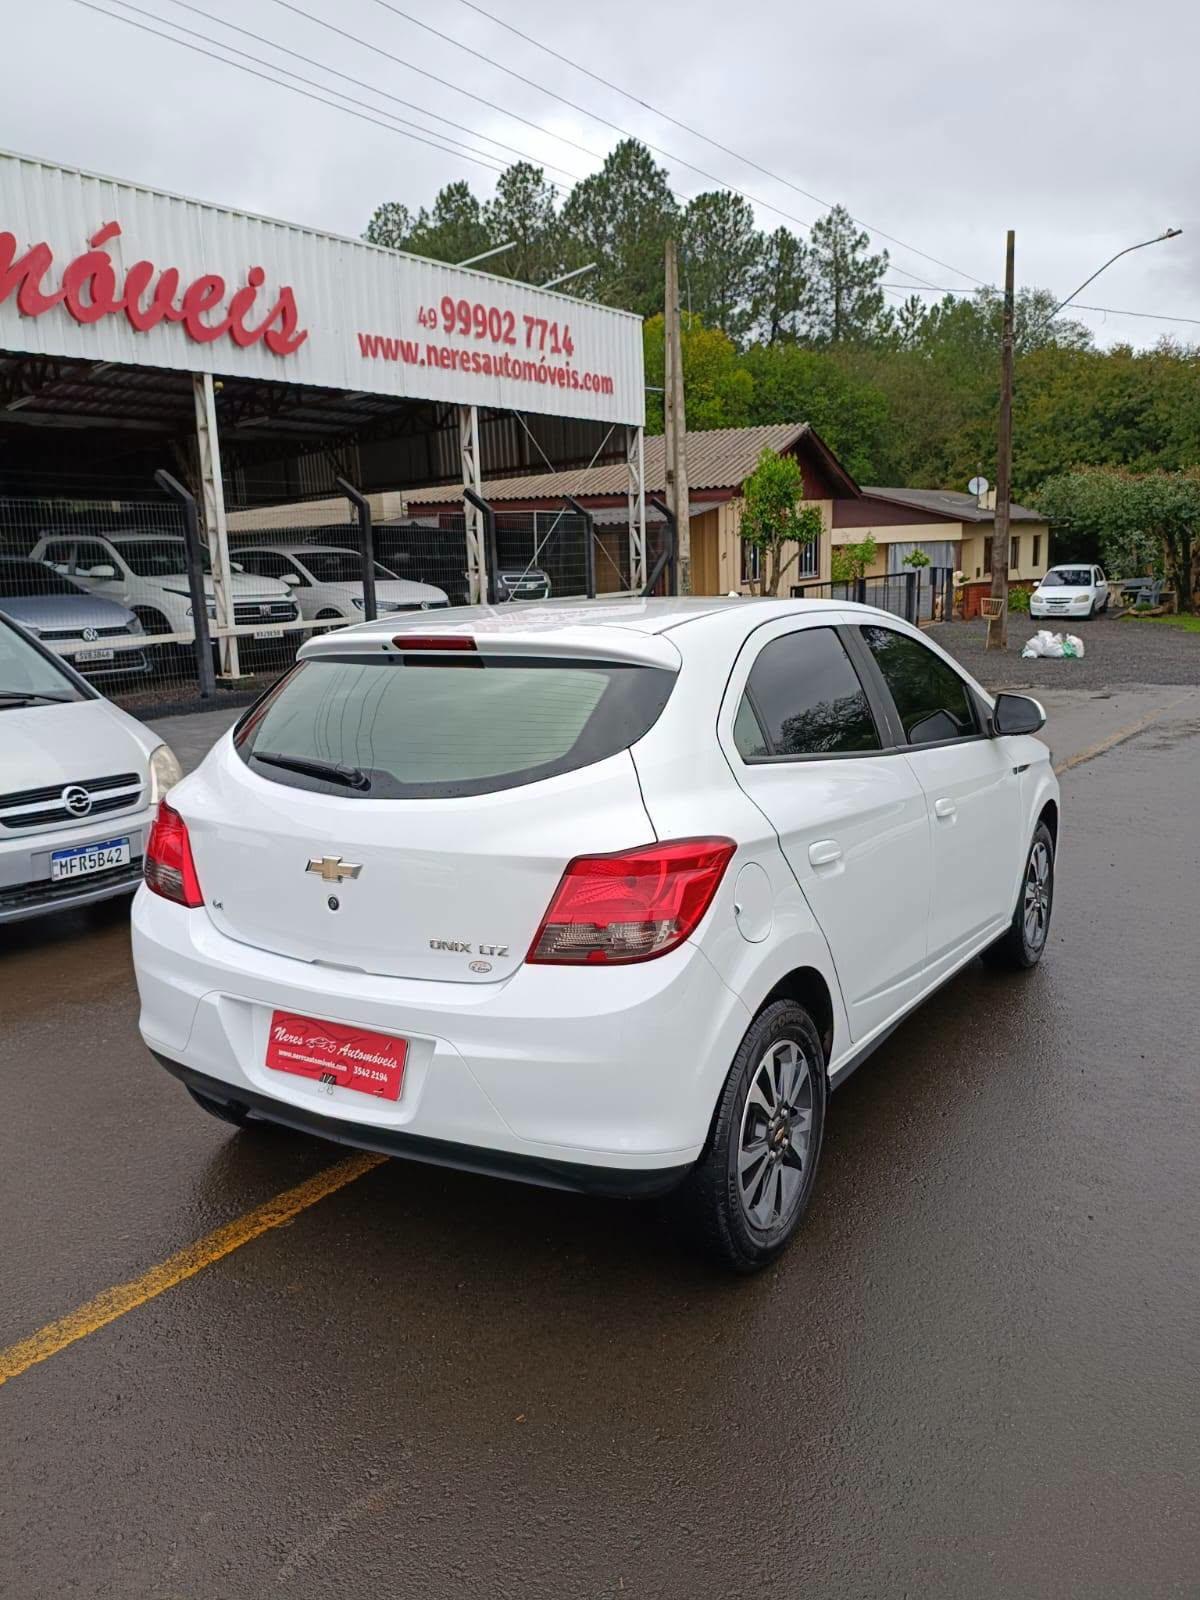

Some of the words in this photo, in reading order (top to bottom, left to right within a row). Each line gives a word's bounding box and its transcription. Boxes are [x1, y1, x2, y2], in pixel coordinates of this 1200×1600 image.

[417, 305, 438, 330] 49
[440, 295, 517, 347] 99902
[522, 314, 575, 358] 7714
[357, 332, 615, 395] www.neresautomóveis.com
[59, 848, 122, 876] MFR5B42
[429, 938, 472, 954] ONIX
[479, 943, 509, 957] LTZ
[273, 1026, 304, 1045] Neres
[337, 1043, 398, 1069] Automóveis
[353, 1065, 371, 1079] 3542
